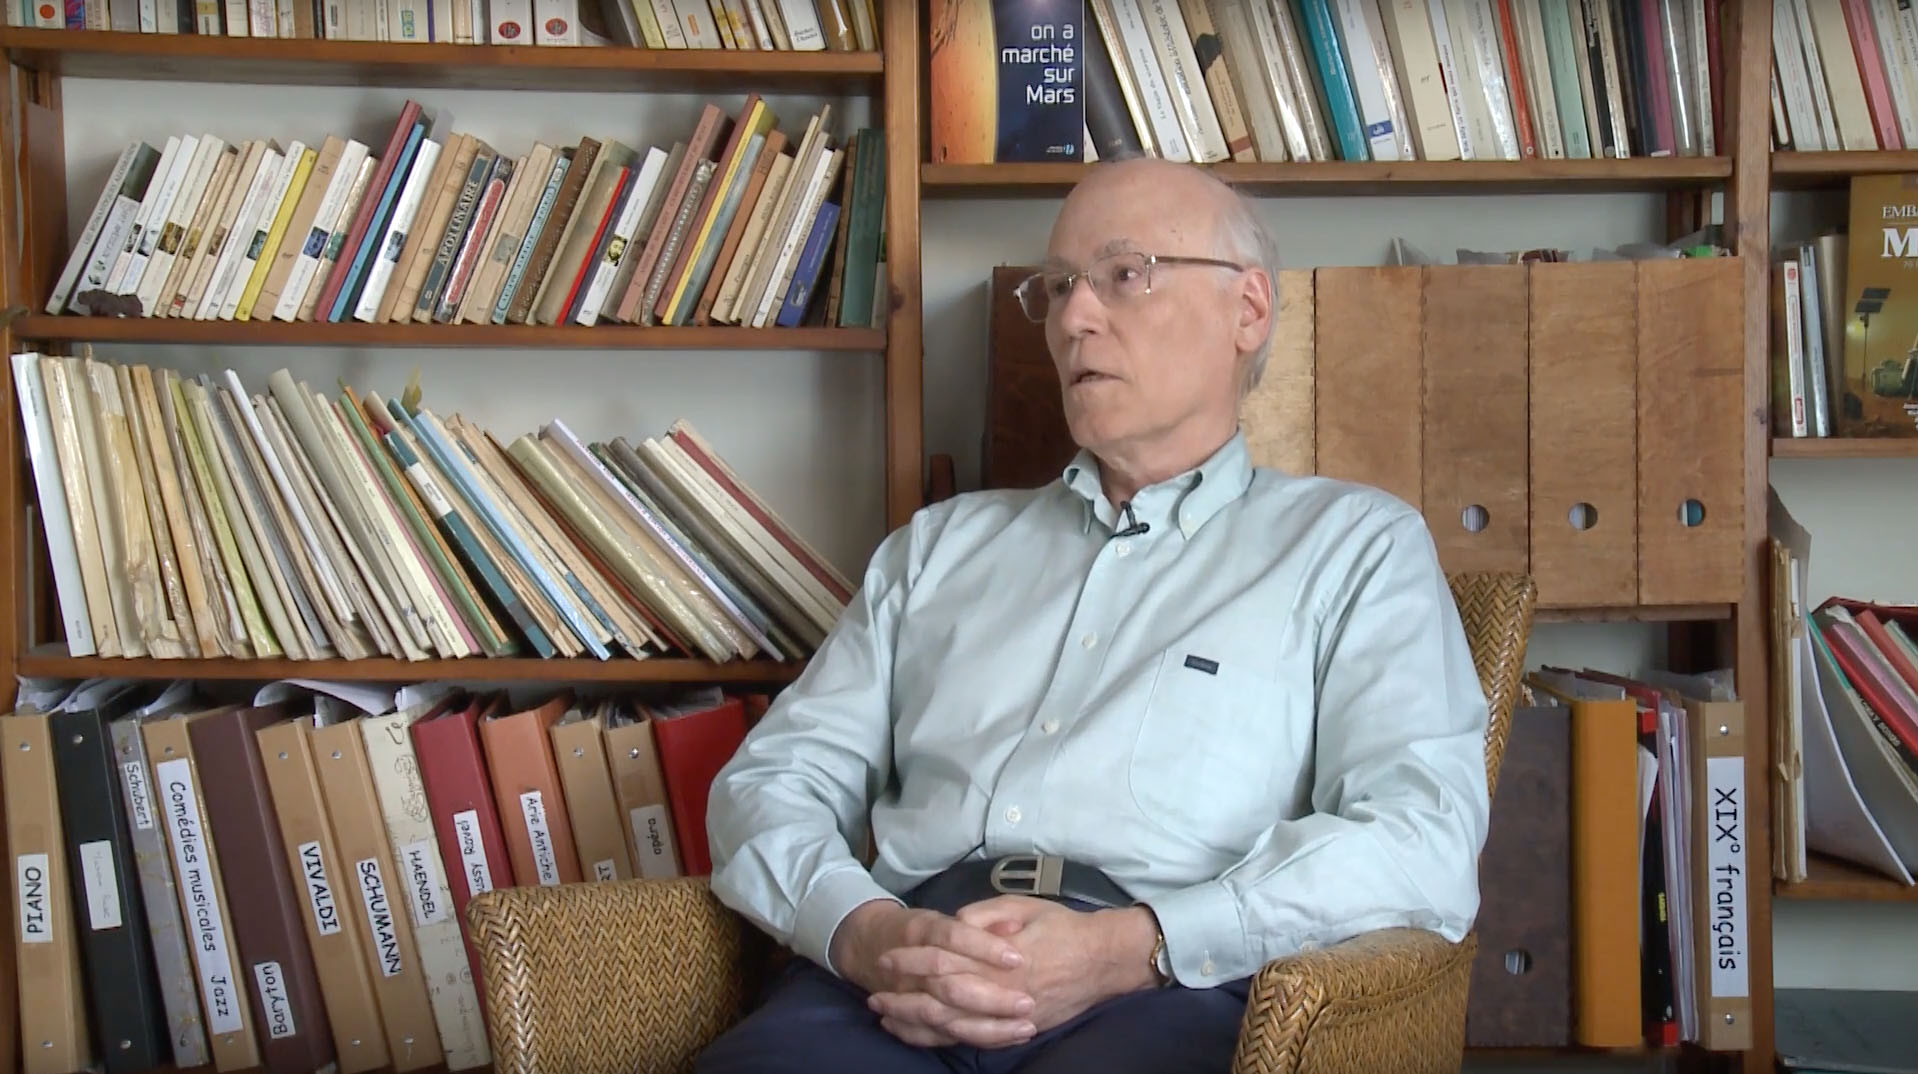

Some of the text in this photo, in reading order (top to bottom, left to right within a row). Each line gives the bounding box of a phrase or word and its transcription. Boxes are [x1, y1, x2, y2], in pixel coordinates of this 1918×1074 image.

[1002, 44, 1075, 63] marché
[1031, 24, 1075, 40] on a
[1025, 85, 1076, 104] Mars
[1043, 67, 1076, 83] sur
[1882, 205, 1918, 218] EMB
[125, 764, 151, 827] Schubert
[25, 866, 43, 934] PIANO
[169, 781, 230, 1018] Comédies musicales Jazz
[302, 845, 339, 931] VIVALDI
[407, 849, 436, 920] HAENDEL
[471, 862, 486, 893] ussy
[360, 861, 402, 974] SCHUMANN
[1712, 863, 1742, 971] français
